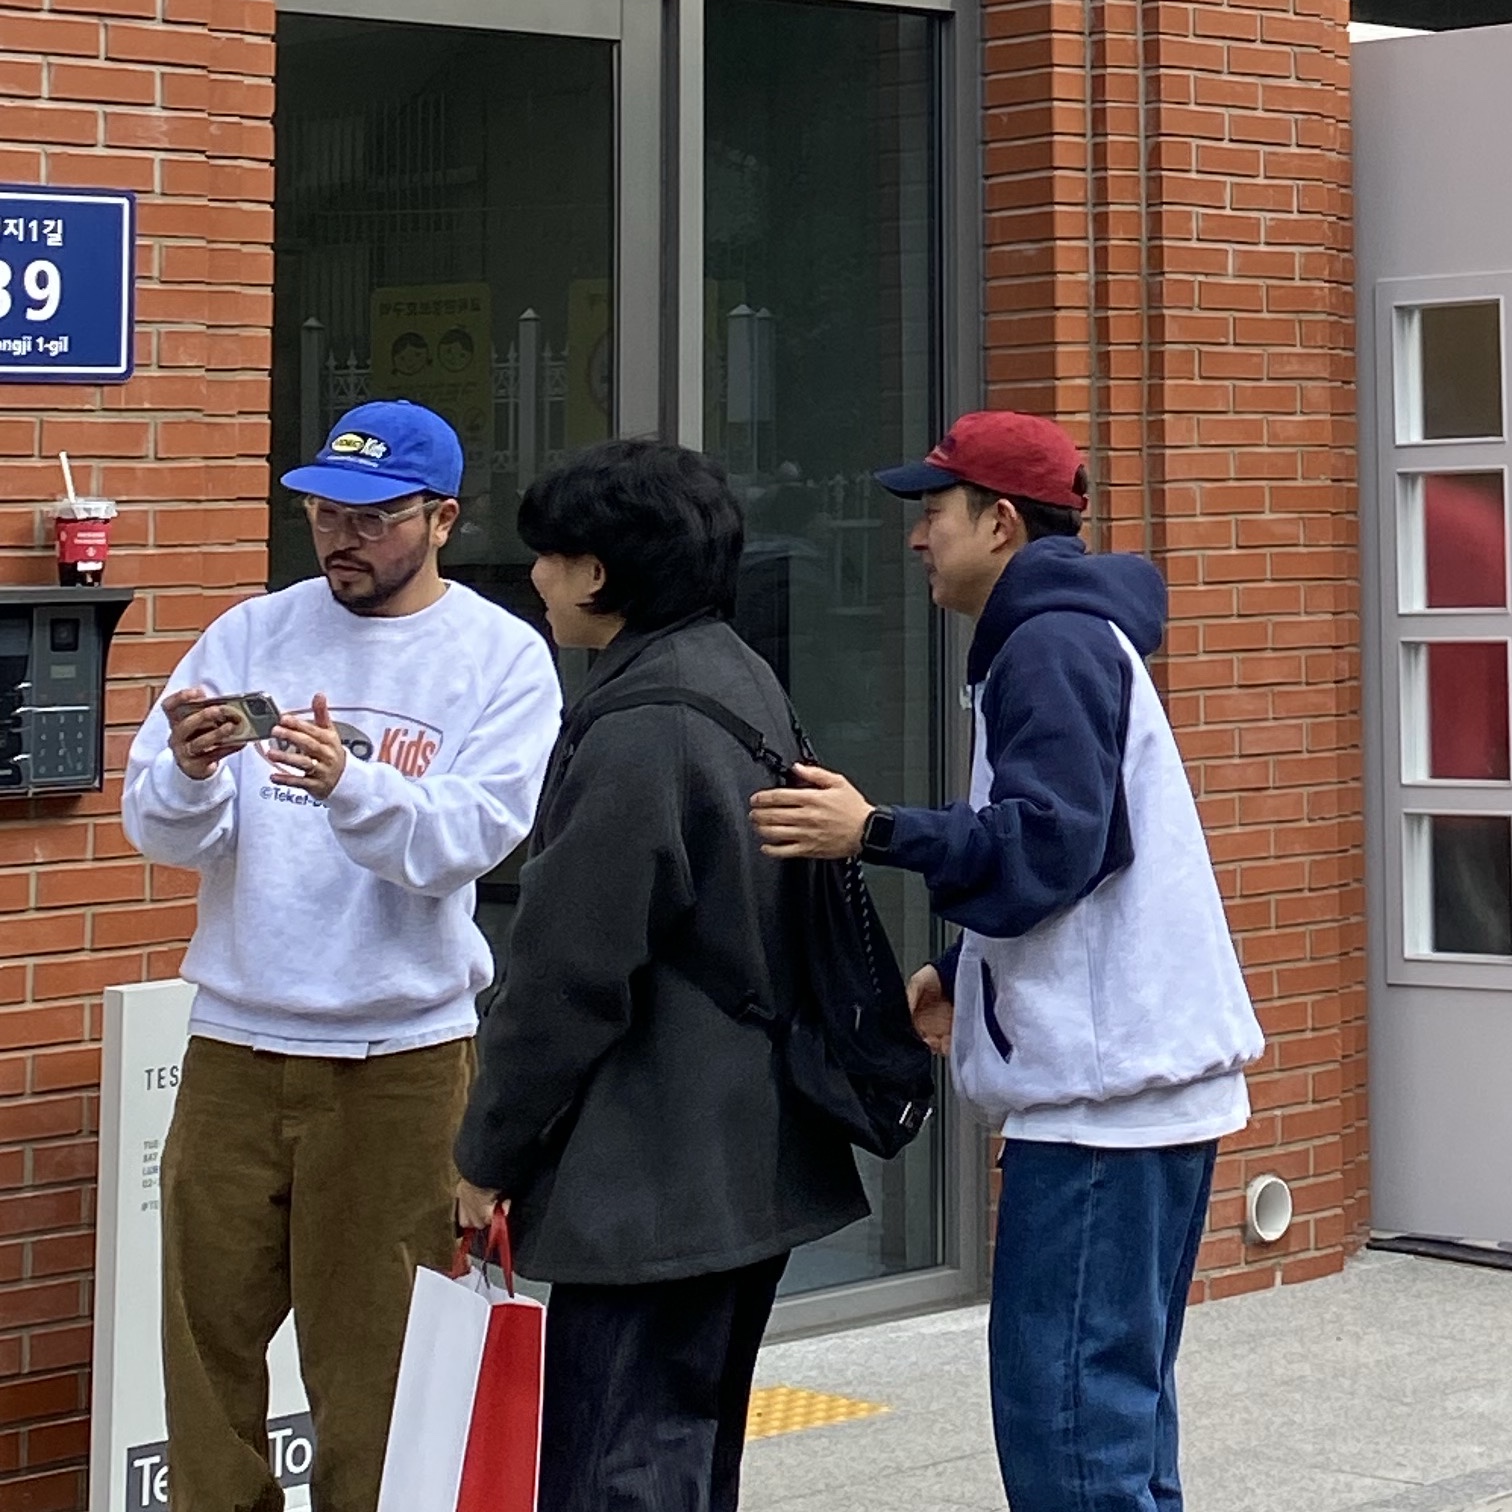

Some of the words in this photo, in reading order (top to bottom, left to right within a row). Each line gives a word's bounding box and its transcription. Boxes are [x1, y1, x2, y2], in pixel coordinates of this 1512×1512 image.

[36, 336, 69, 357] 1-gil
[377, 727, 437, 779] Kids
[268, 1428, 313, 1479] To
